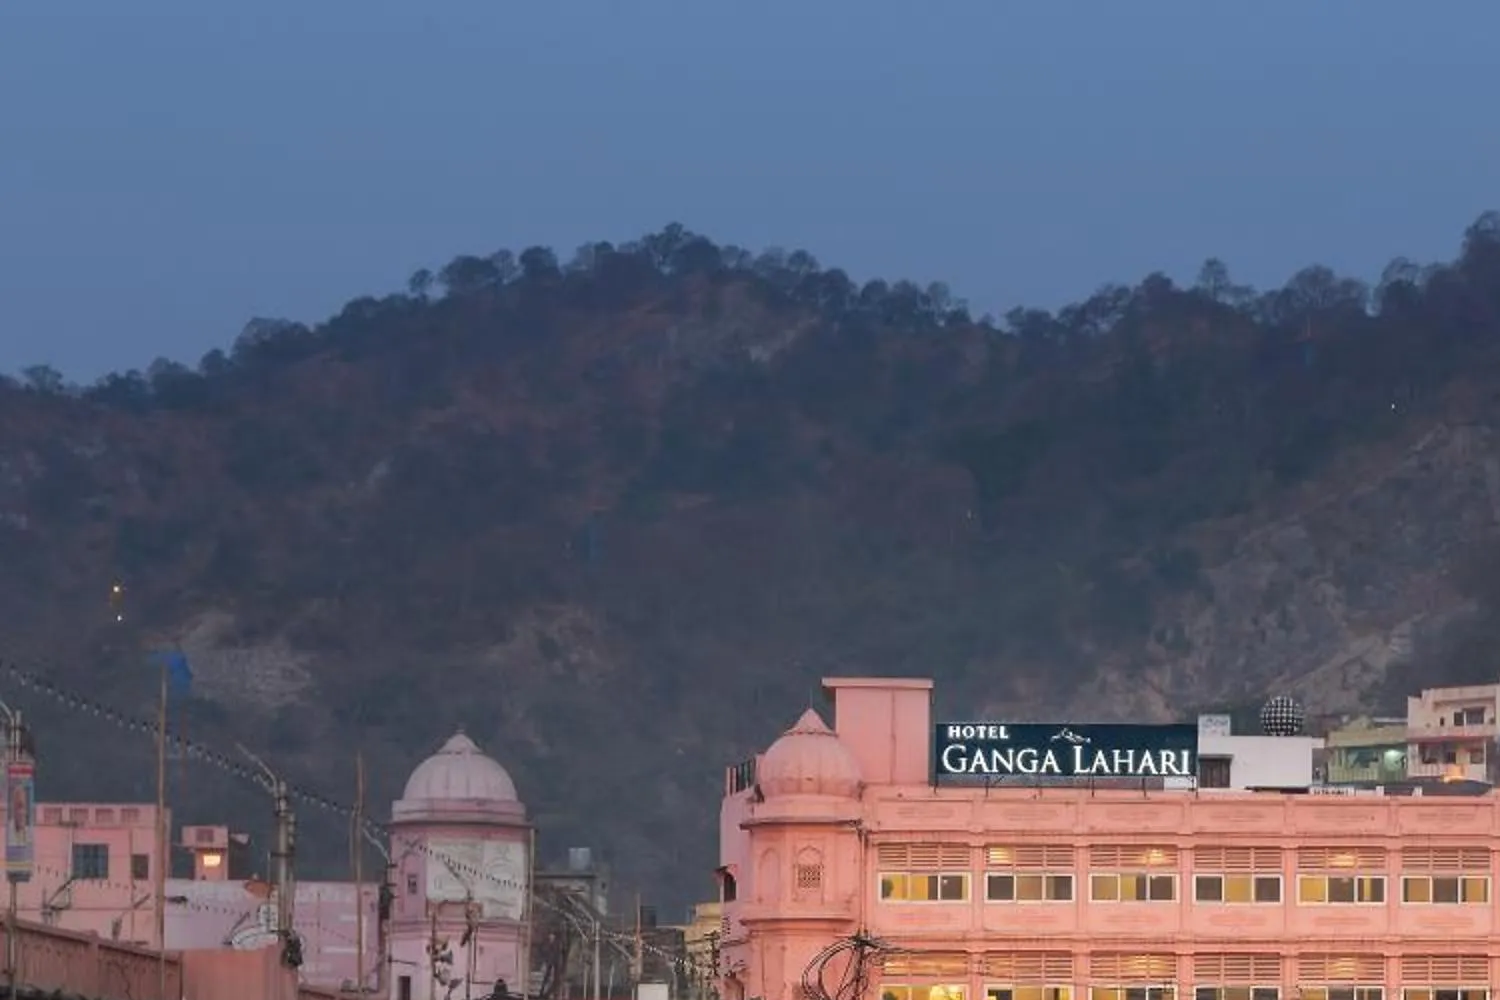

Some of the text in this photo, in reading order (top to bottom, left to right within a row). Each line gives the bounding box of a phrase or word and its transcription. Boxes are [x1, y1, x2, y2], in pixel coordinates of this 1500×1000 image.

[947, 725, 1009, 739] HOTEL
[942, 744, 1191, 775] GANGA LAHARI
